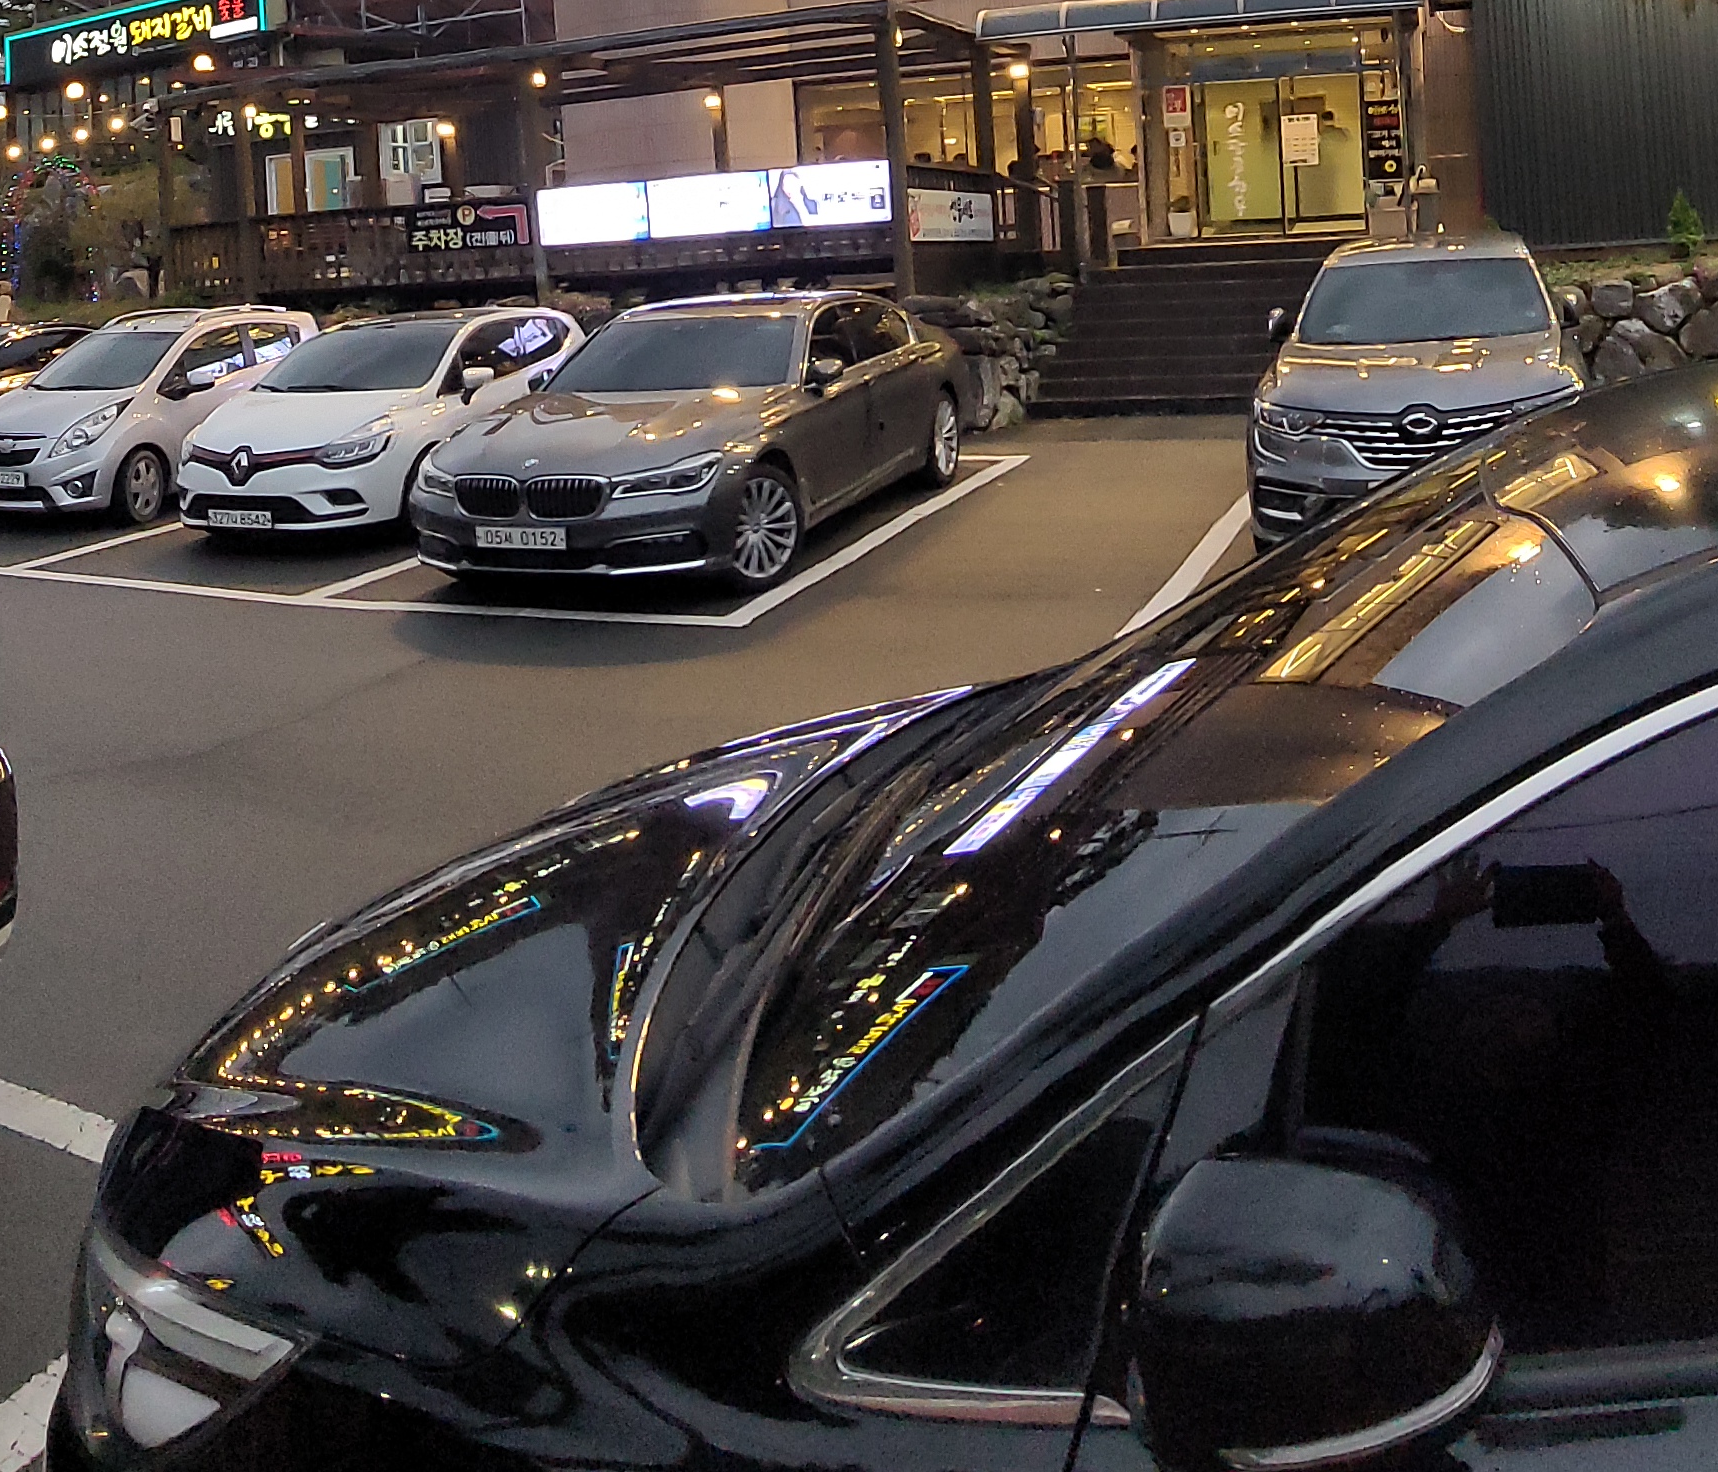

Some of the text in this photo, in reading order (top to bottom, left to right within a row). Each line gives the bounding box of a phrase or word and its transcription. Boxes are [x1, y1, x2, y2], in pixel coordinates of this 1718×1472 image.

[51, 19, 128, 66] 미소정원
[130, 4, 213, 46] 돼지갈비
[410, 227, 464, 251] 주차장
[520, 530, 557, 547] 0152
